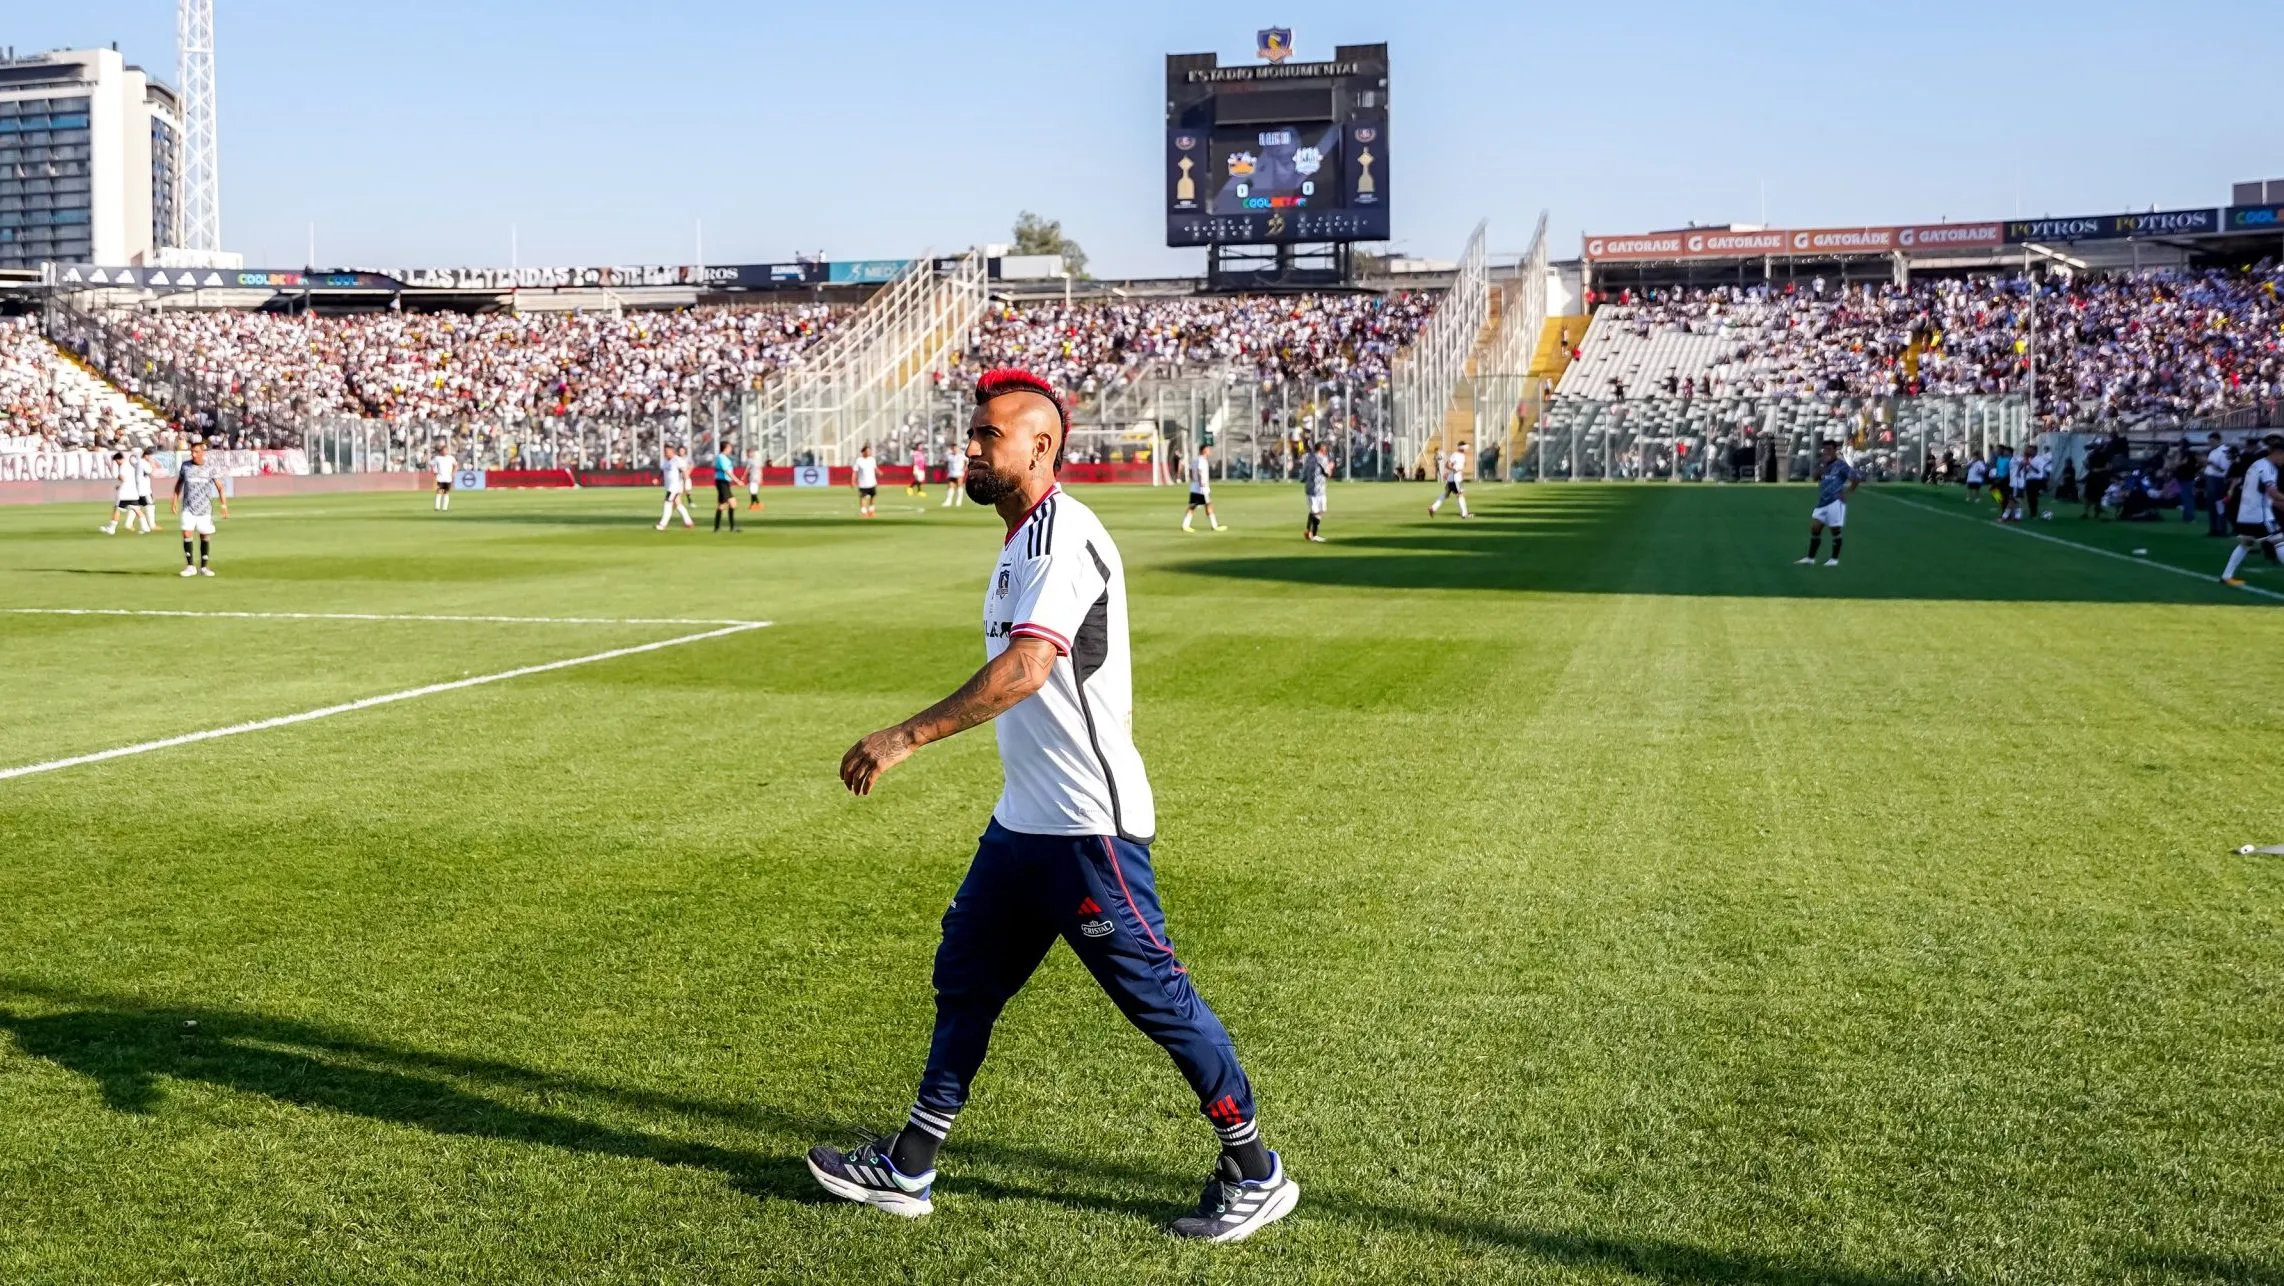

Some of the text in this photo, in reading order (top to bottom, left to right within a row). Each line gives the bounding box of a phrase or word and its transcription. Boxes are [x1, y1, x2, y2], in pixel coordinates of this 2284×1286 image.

[1188, 62, 1359, 82] ESTADIO MONUMENTAL
[2011, 219, 2099, 237] POTROS
[2115, 211, 2207, 232] POTROS
[1814, 232, 1891, 246] GATORADE
[1919, 227, 1997, 242] GATORADE
[1607, 239, 1681, 253] GATORADE
[1707, 236, 1781, 249] GATORADE
[1083, 924, 1111, 935] CRISTAL
